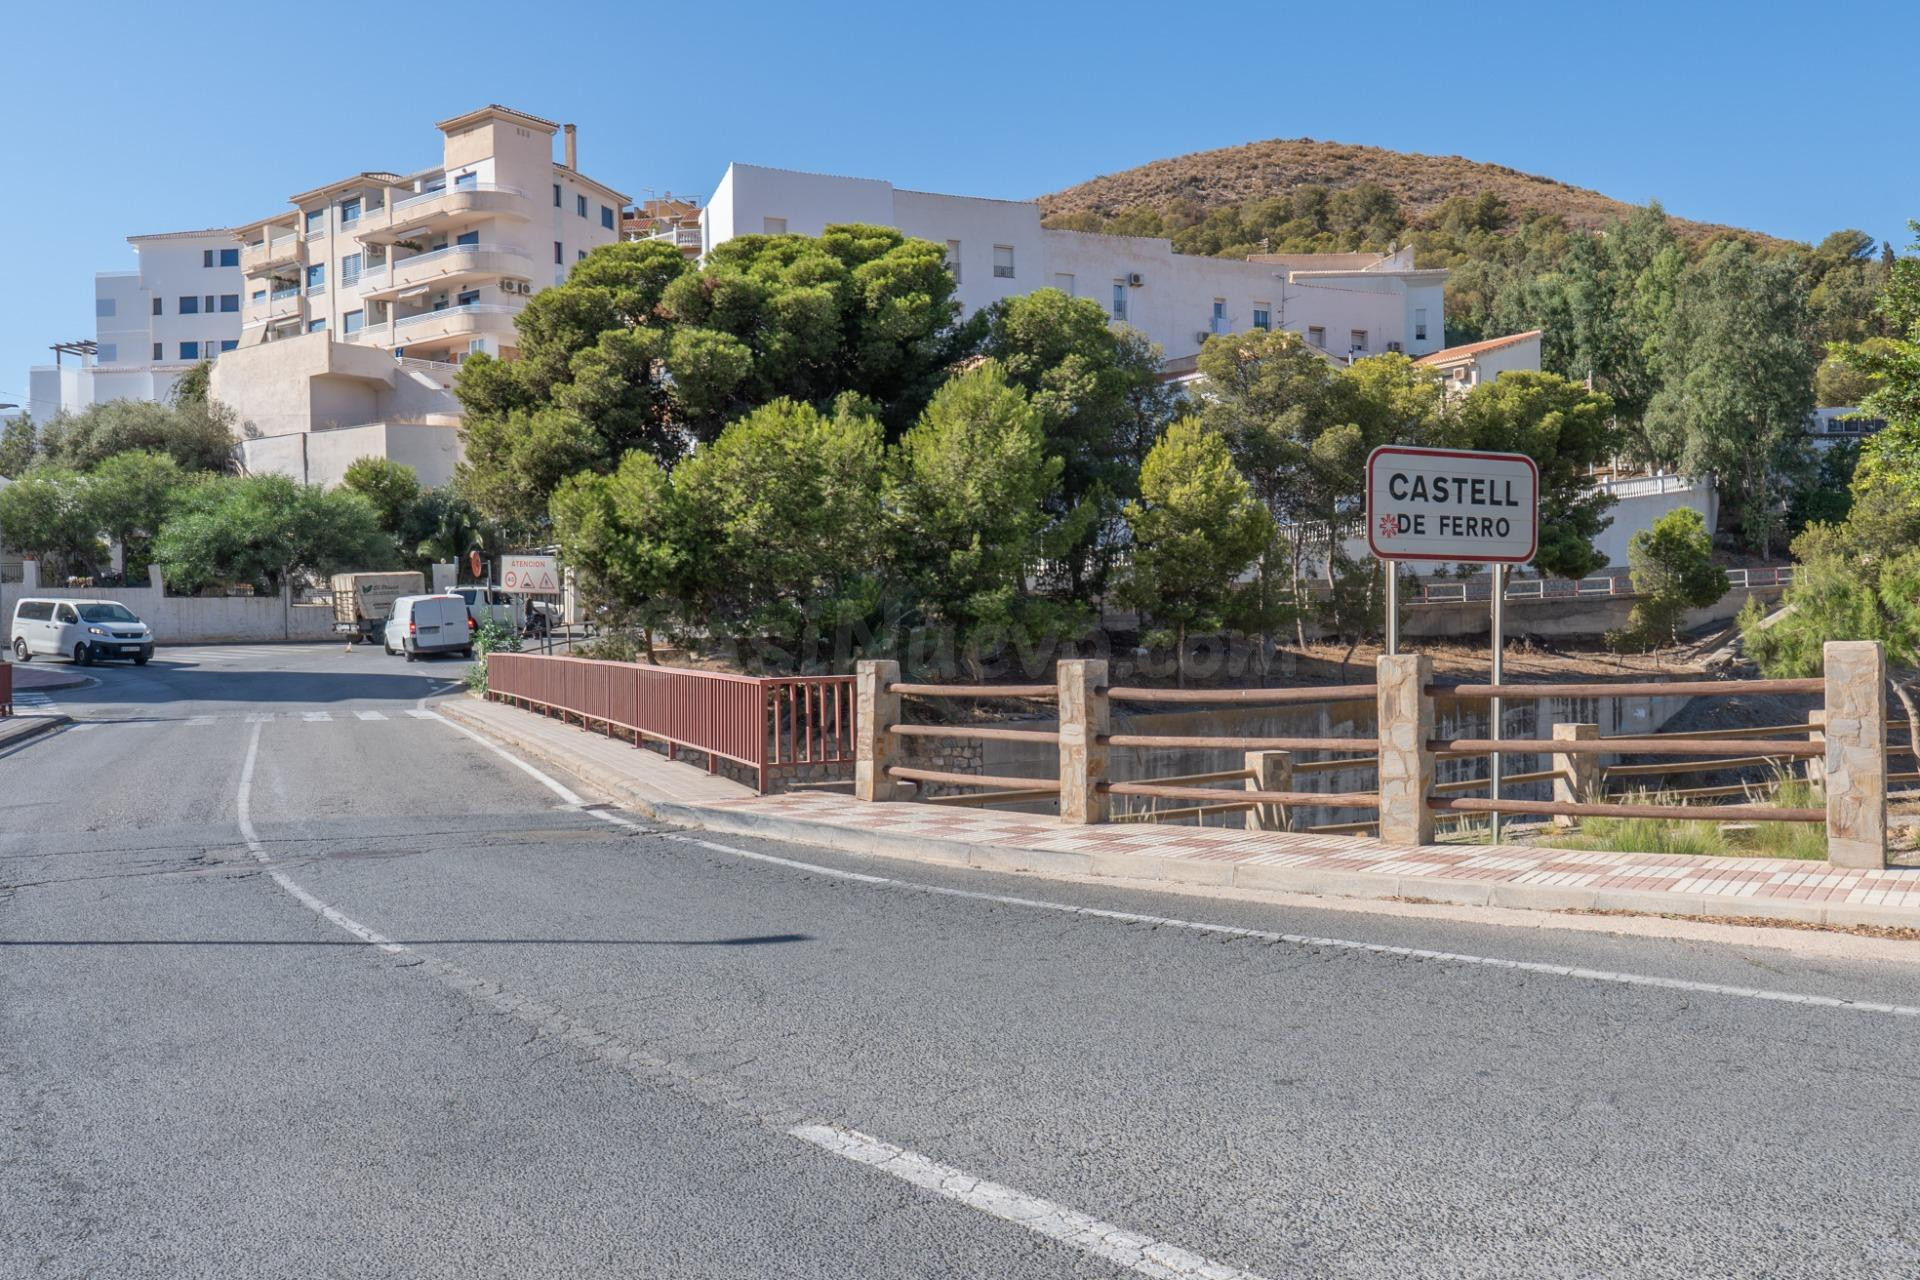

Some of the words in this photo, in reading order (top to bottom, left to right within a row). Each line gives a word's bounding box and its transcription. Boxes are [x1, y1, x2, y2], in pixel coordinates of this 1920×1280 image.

[1389, 473, 1519, 506] CASTELL
[1397, 513, 1426, 535] DE
[1440, 515, 1510, 538] FERRO
